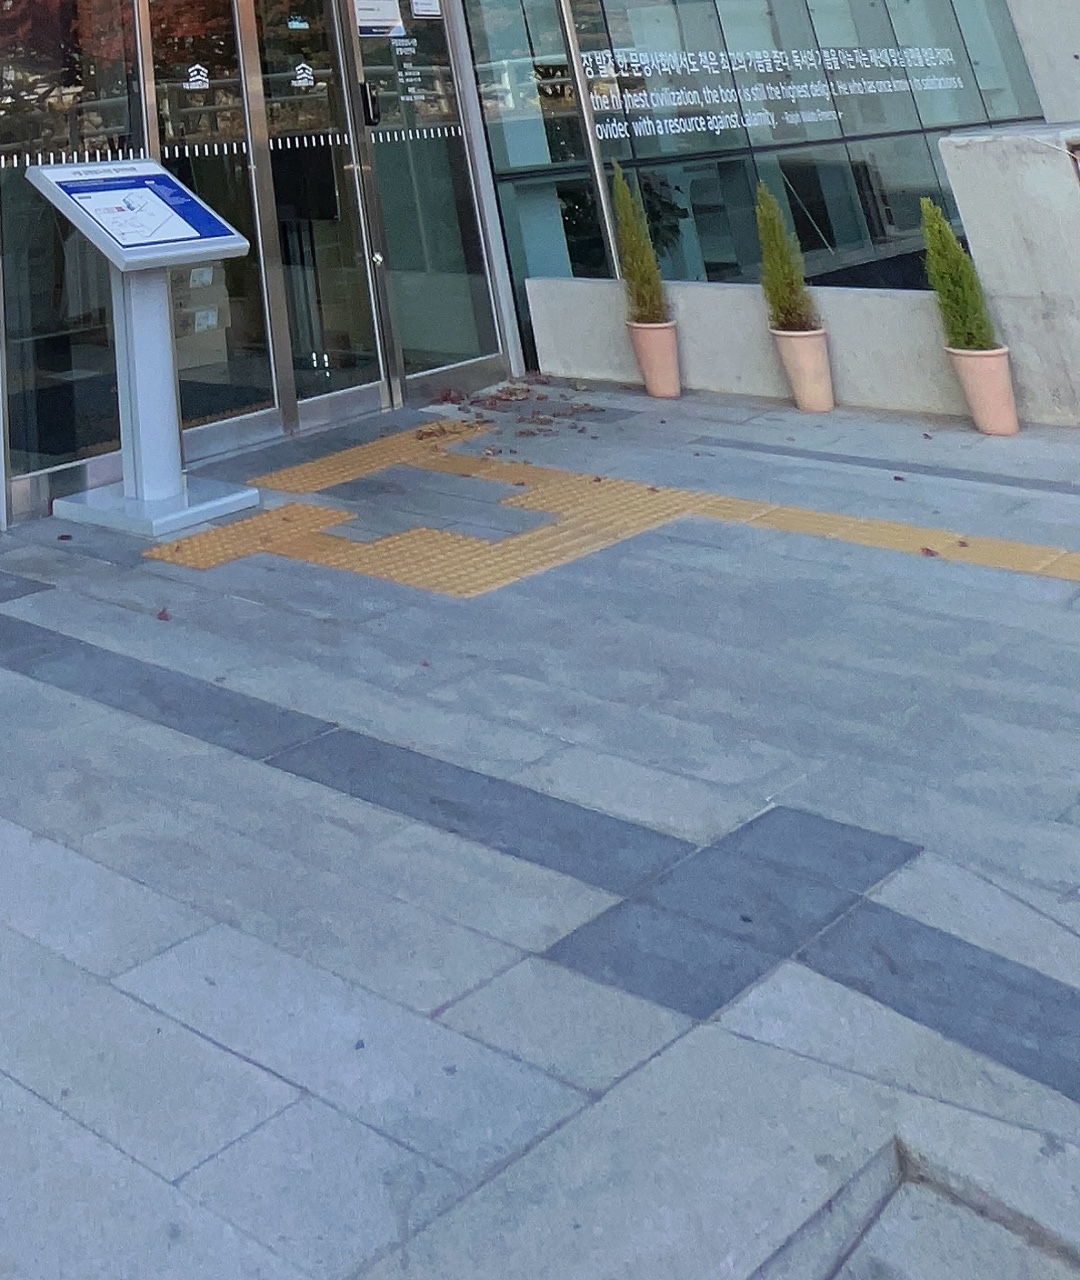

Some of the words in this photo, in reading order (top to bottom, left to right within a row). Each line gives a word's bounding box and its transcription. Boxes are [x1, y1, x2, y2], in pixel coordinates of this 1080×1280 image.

[581, 53, 594, 79] 장
[699, 50, 720, 75] 책은
[589, 91, 610, 111] the
[650, 86, 704, 108] civilization,
[702, 85, 720, 104] the
[766, 82, 781, 100] the
[595, 117, 630, 140] ovided
[631, 115, 657, 137] with
[656, 120, 664, 134] a
[663, 116, 706, 135] resource
[707, 111, 741, 135] against
